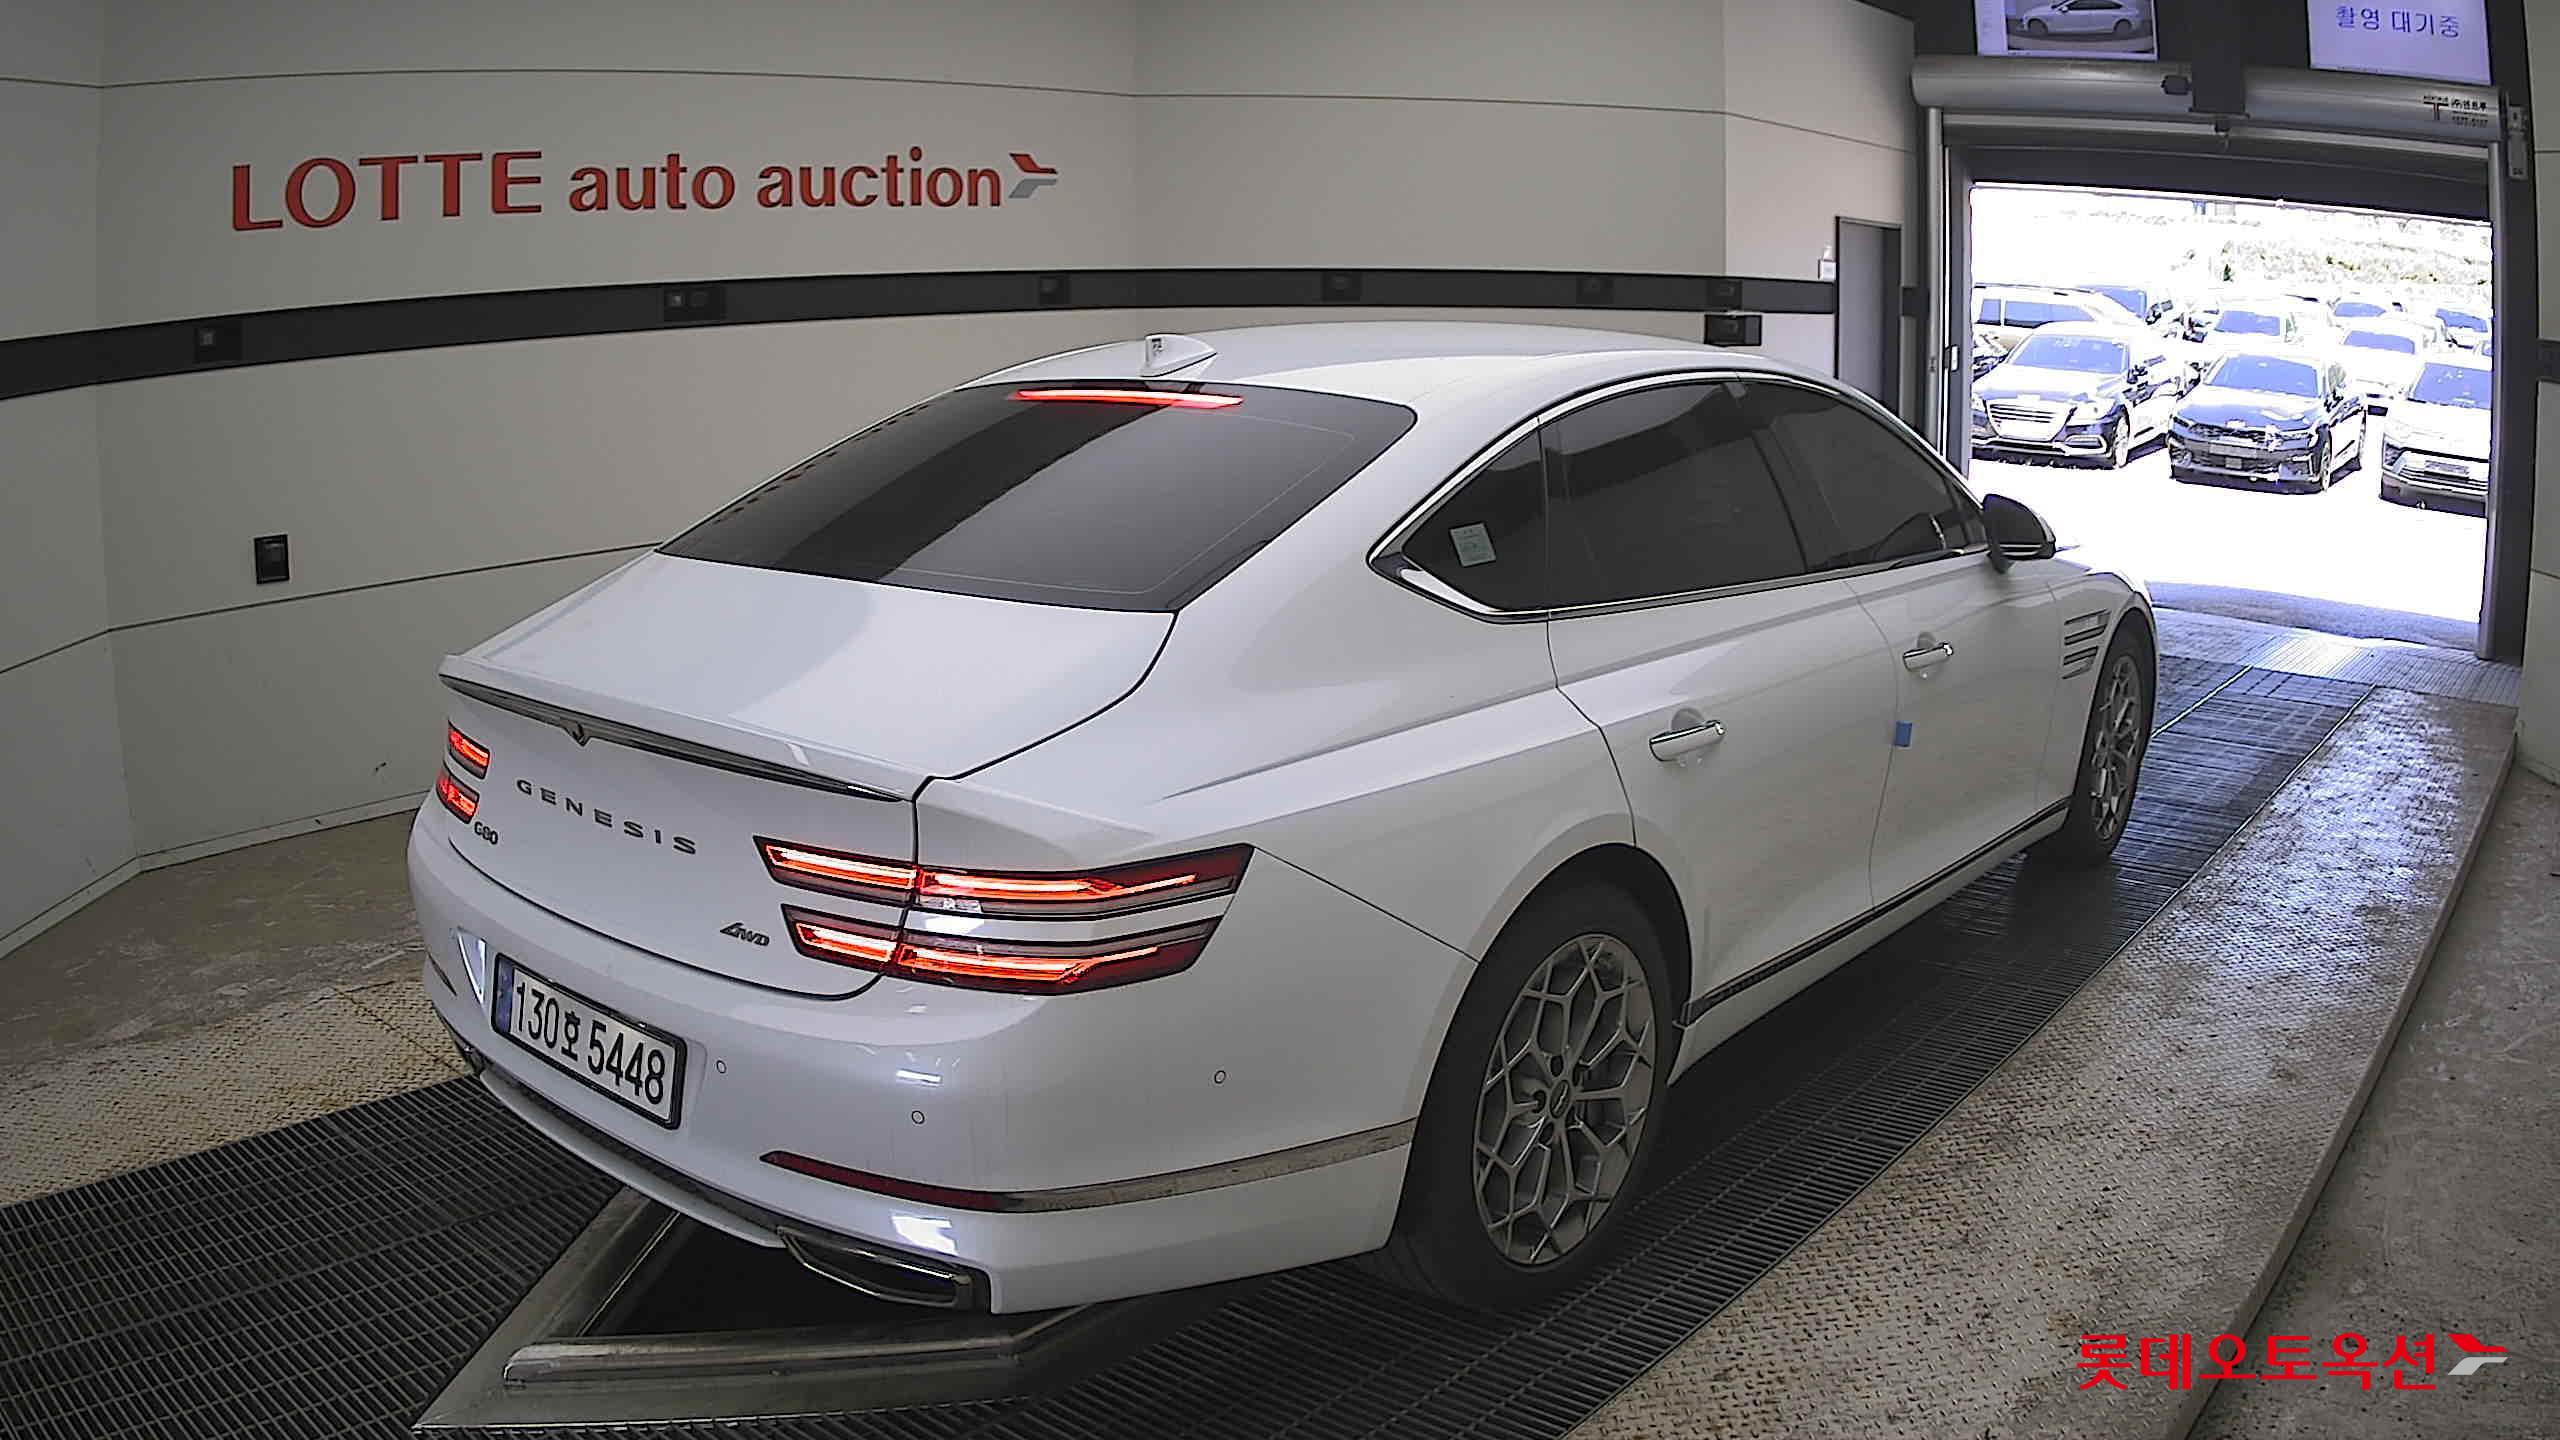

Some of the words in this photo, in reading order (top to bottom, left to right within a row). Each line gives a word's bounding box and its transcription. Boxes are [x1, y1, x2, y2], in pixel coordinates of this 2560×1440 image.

[2336, 5, 2380, 31] 촬영
[2391, 10, 2460, 39] 대기중
[232, 150, 542, 232] LOTTE
[567, 152, 736, 211] auto
[756, 146, 1003, 208] auction
[473, 820, 499, 846] G80
[515, 778, 698, 855] GENESIS
[719, 922, 771, 947] 4WD
[587, 1019, 666, 1105] 5448
